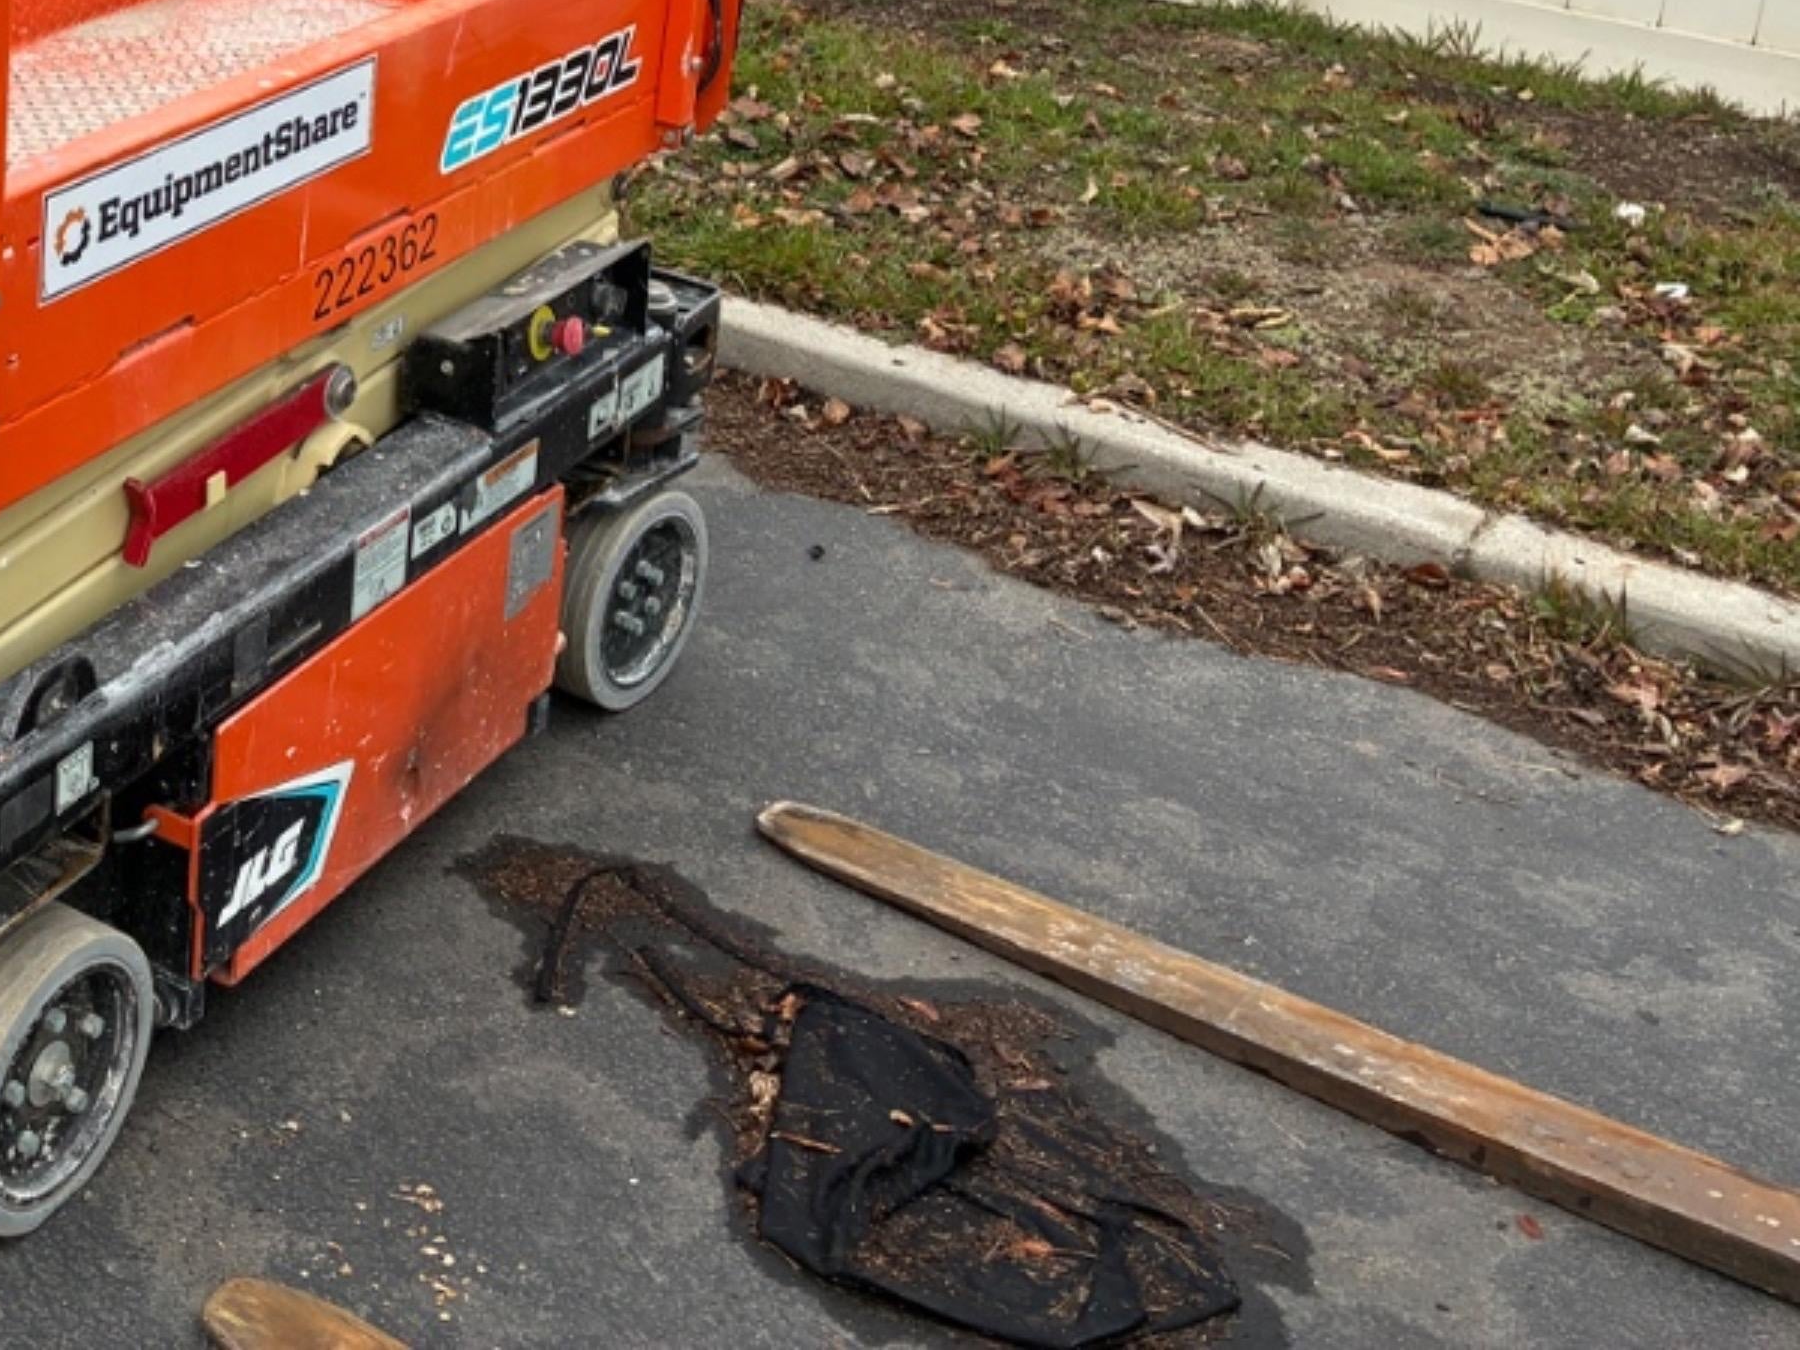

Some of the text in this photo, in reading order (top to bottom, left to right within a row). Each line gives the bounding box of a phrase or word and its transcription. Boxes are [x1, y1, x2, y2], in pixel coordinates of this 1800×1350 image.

[442, 26, 641, 172] ES1330L
[98, 100, 359, 244] EquipmentShare
[313, 212, 438, 321] 222362
[216, 816, 305, 930] JLG
